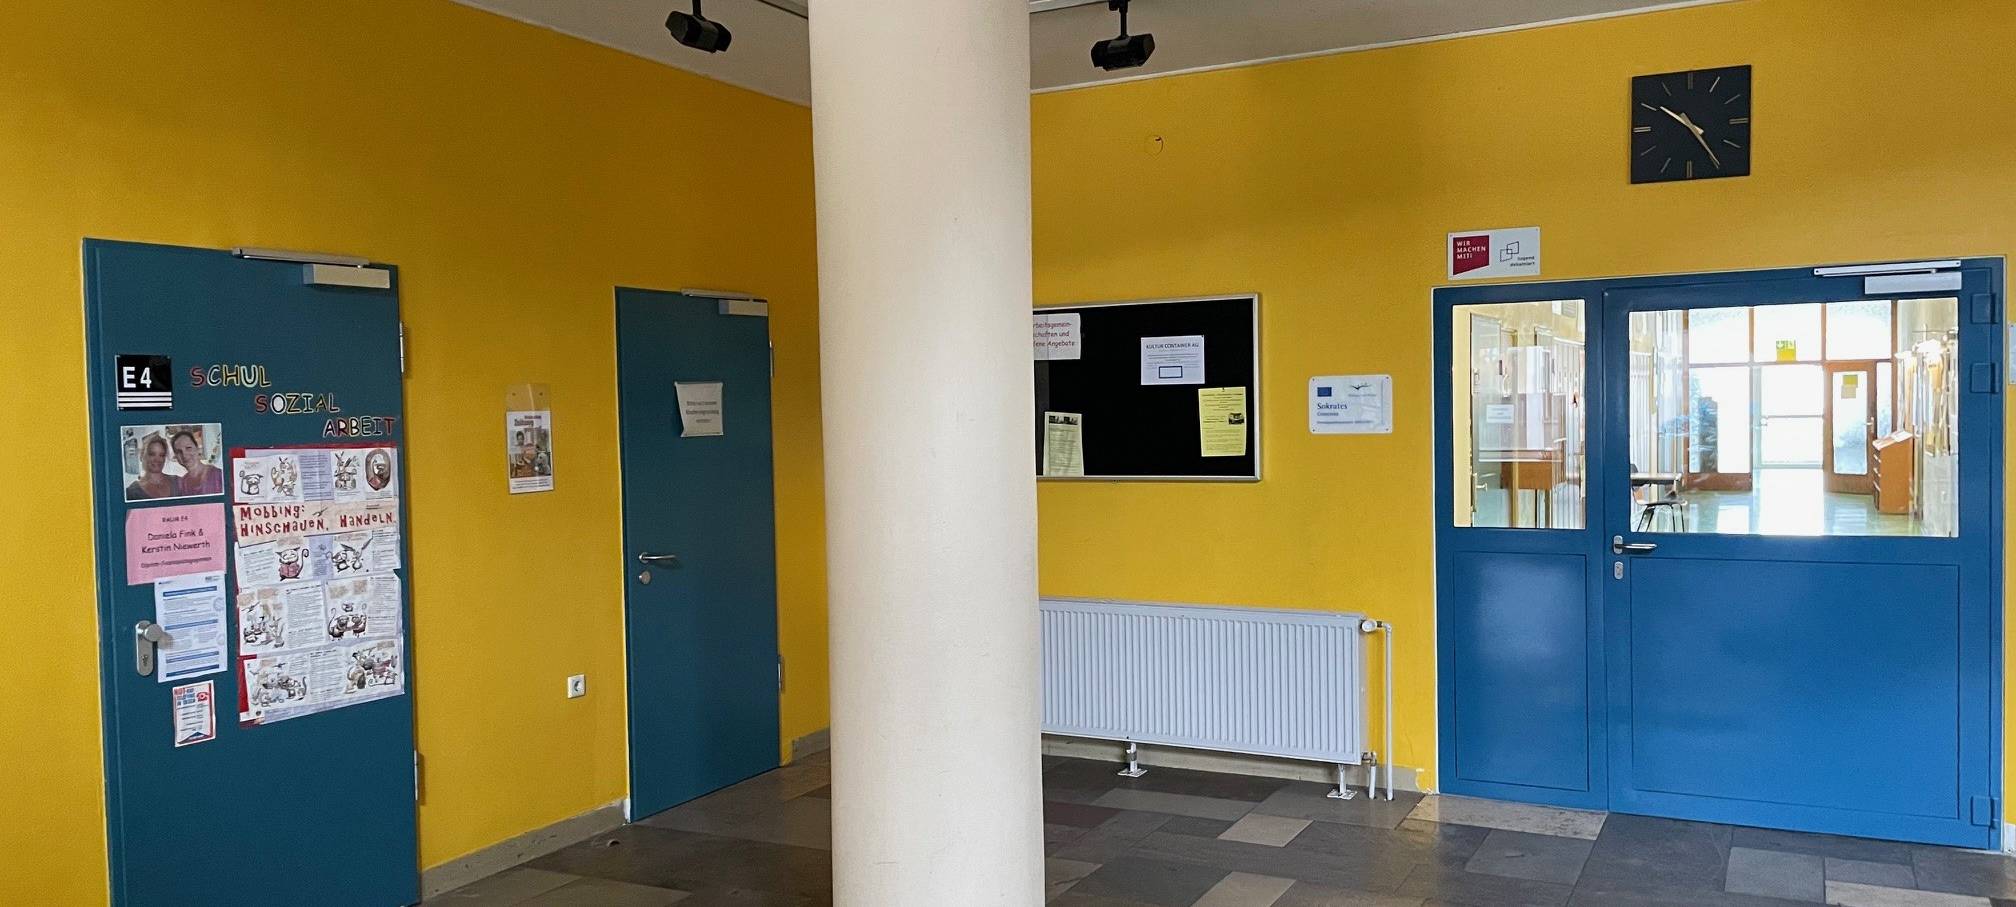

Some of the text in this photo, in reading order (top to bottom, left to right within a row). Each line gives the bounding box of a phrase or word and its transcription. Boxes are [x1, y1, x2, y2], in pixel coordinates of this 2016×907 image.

[1059, 330, 1070, 338] und
[122, 366, 153, 389] E4
[190, 364, 271, 388] SCHUL
[254, 392, 340, 414] SOZIAL
[1317, 402, 1348, 410] Sokrates
[322, 416, 396, 438] ARBEIT
[147, 533, 177, 541] Daniela
[179, 529, 196, 538] Fink
[141, 540, 211, 554] Kerstin Niewerth
